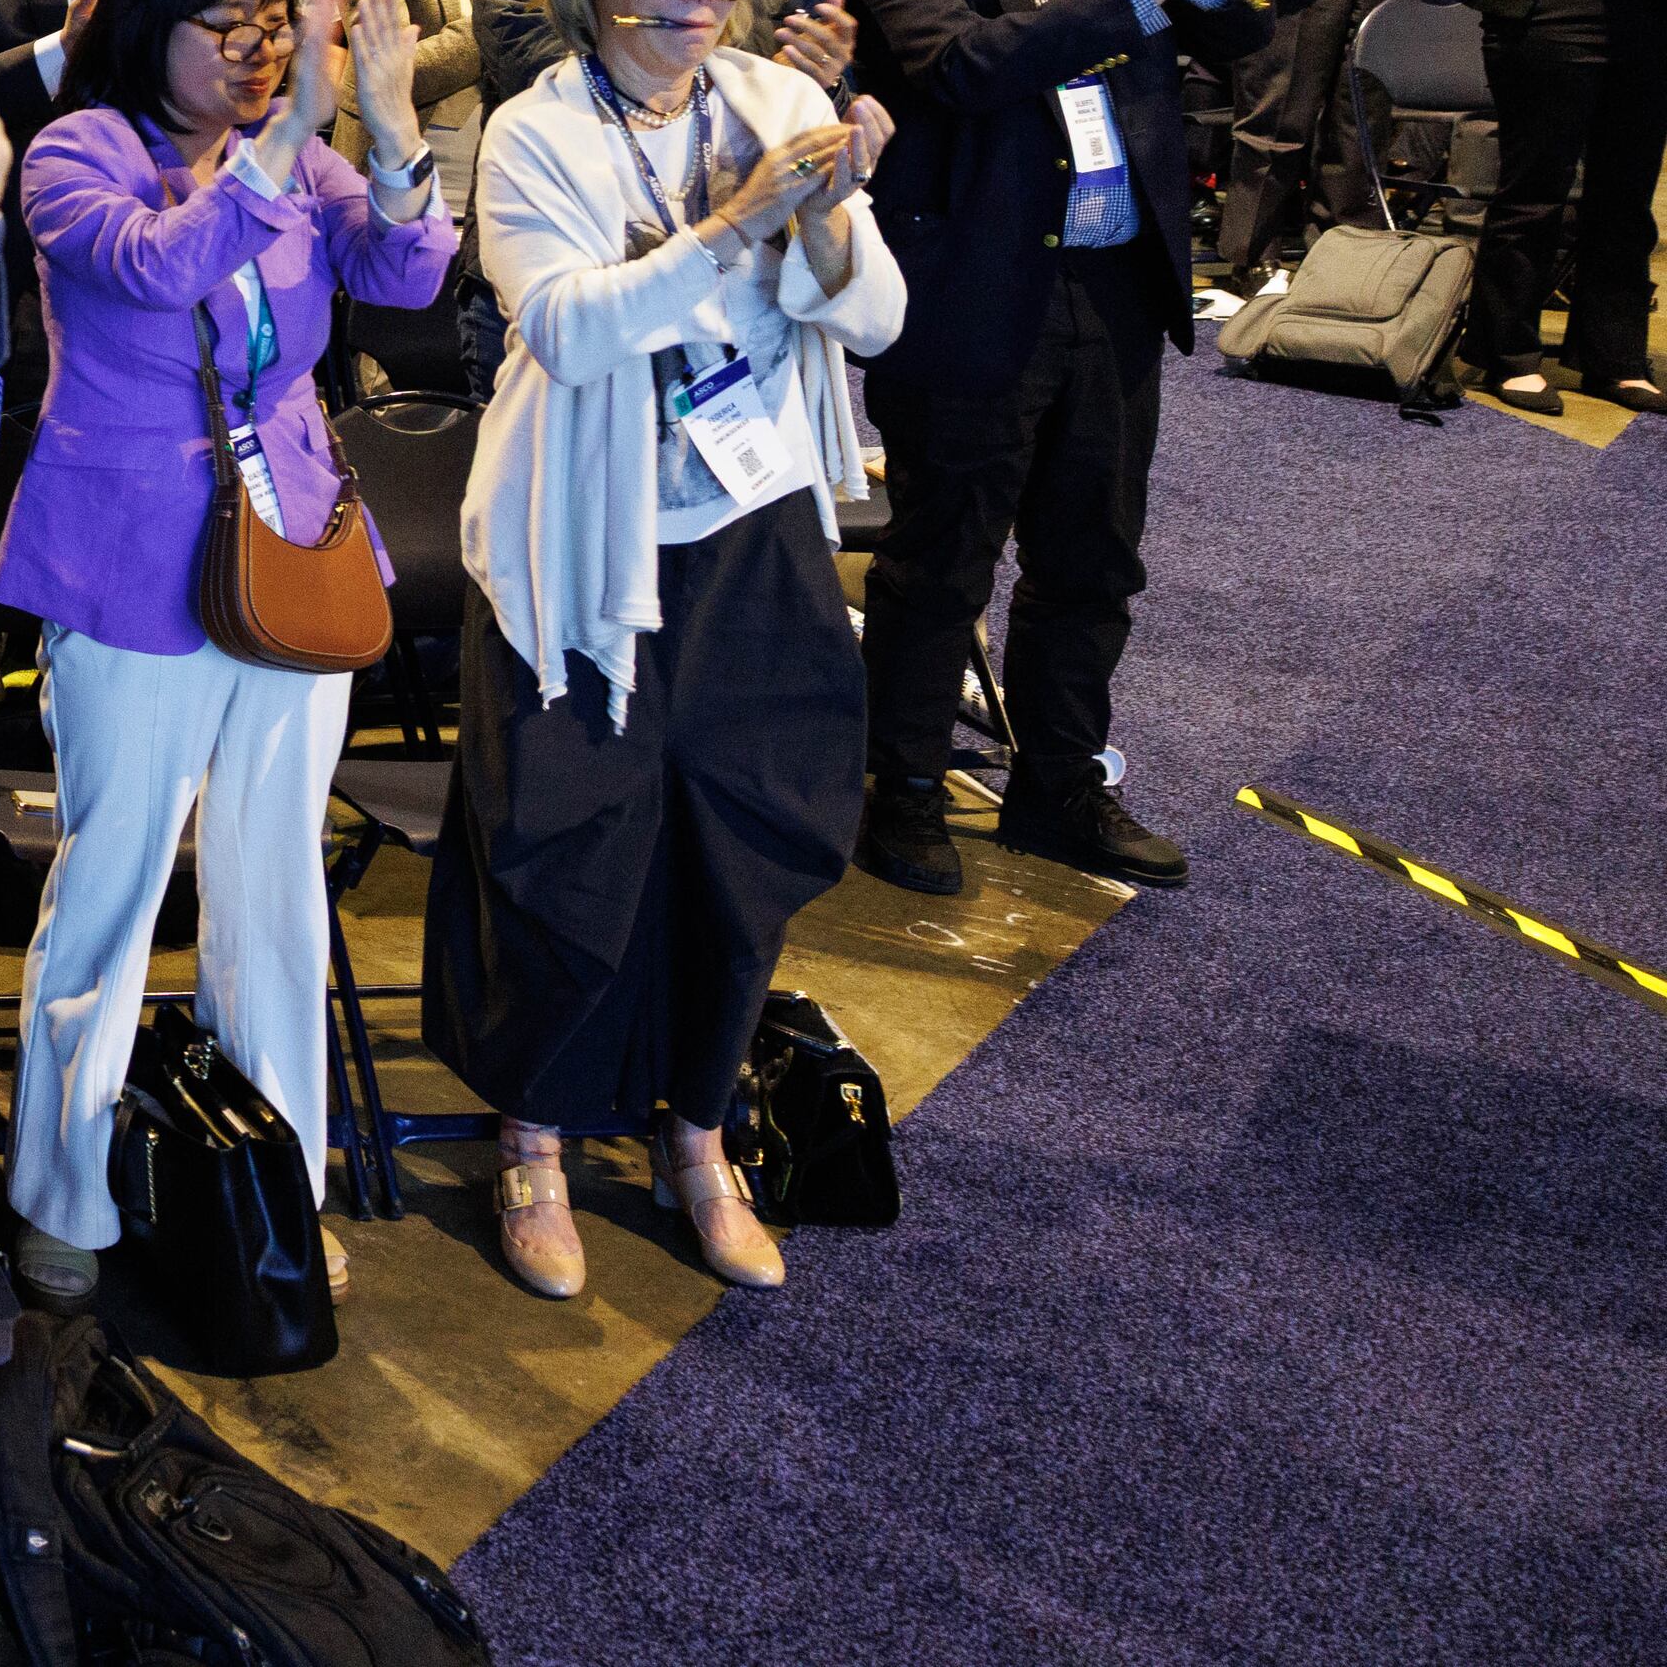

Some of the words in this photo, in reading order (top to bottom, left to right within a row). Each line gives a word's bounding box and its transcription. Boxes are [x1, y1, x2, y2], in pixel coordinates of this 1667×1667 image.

[595, 76, 612, 99] ASCO
[697, 90, 708, 117] ASCO
[693, 381, 714, 399] ASCO
[238, 439, 255, 452] ASCO
